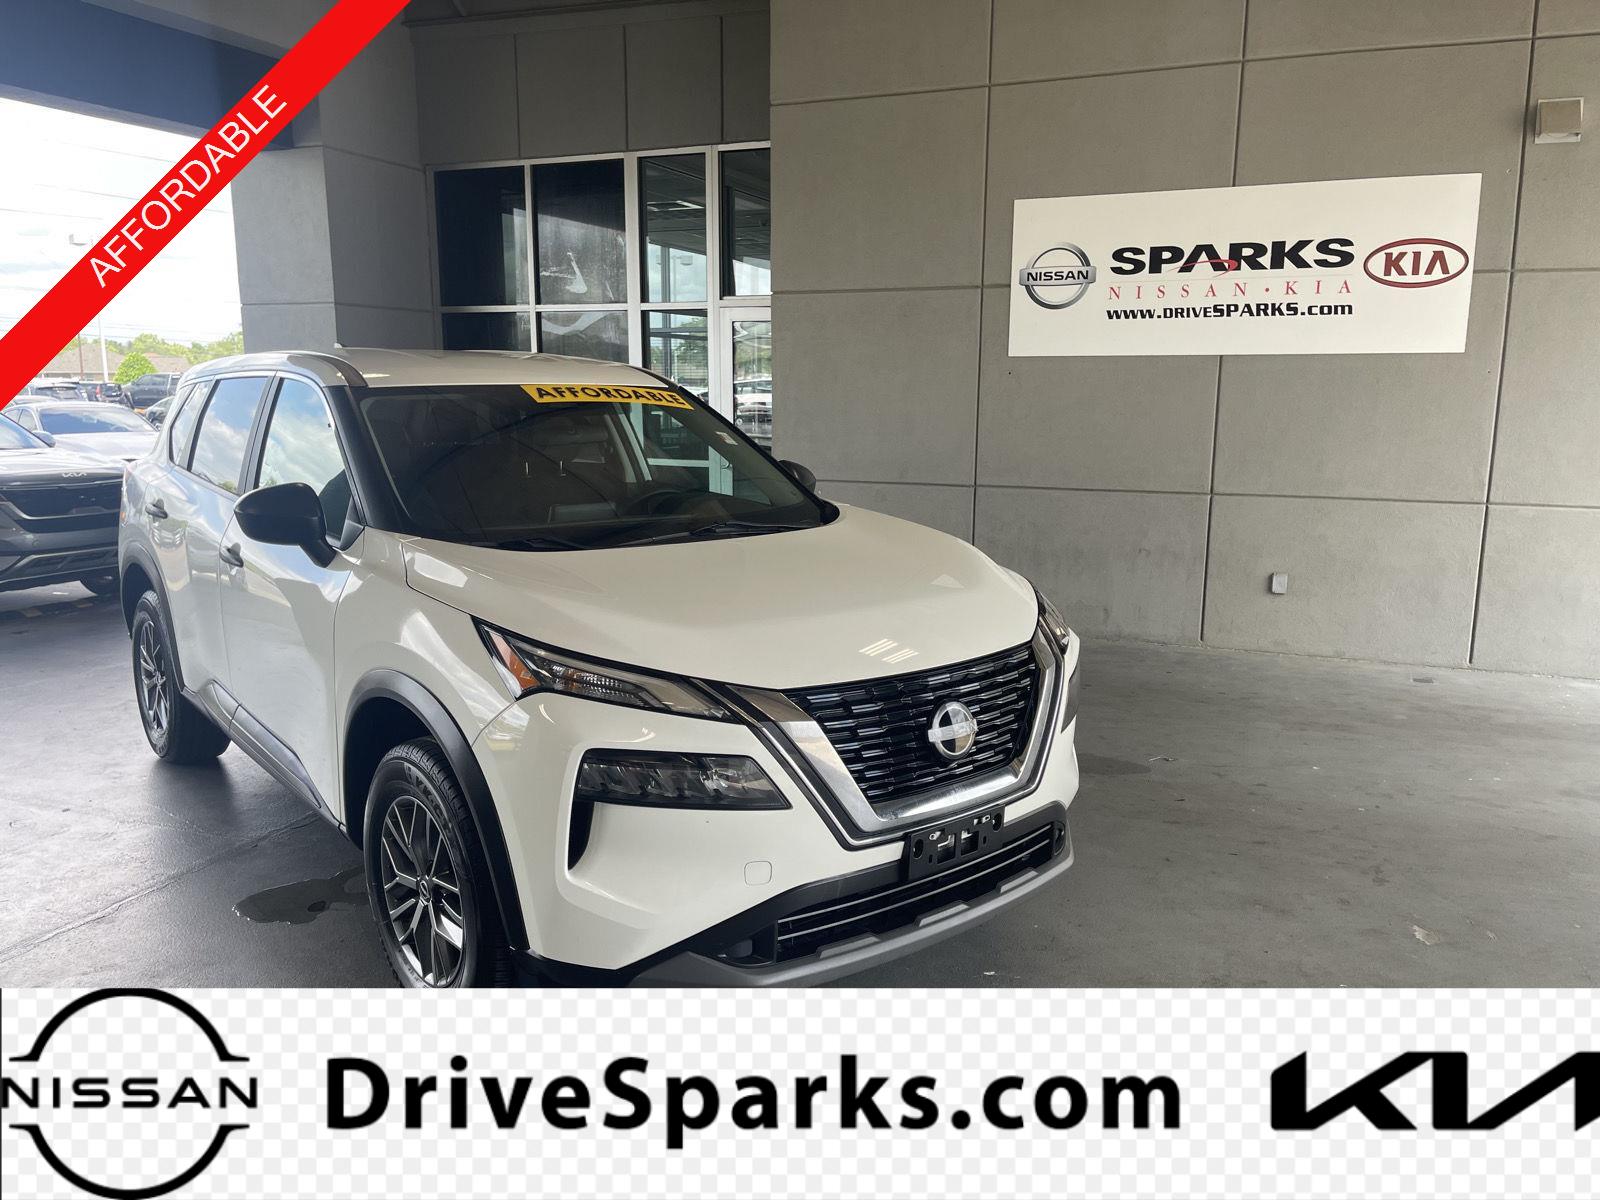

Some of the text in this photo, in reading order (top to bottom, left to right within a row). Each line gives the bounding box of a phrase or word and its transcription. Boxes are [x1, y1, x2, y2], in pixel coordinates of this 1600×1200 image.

[1110, 238, 1355, 276] SPARKS
[1383, 249, 1451, 277] KIA
[1026, 269, 1090, 283] NISSAN
[536, 387, 686, 405] AFFORDABLE
